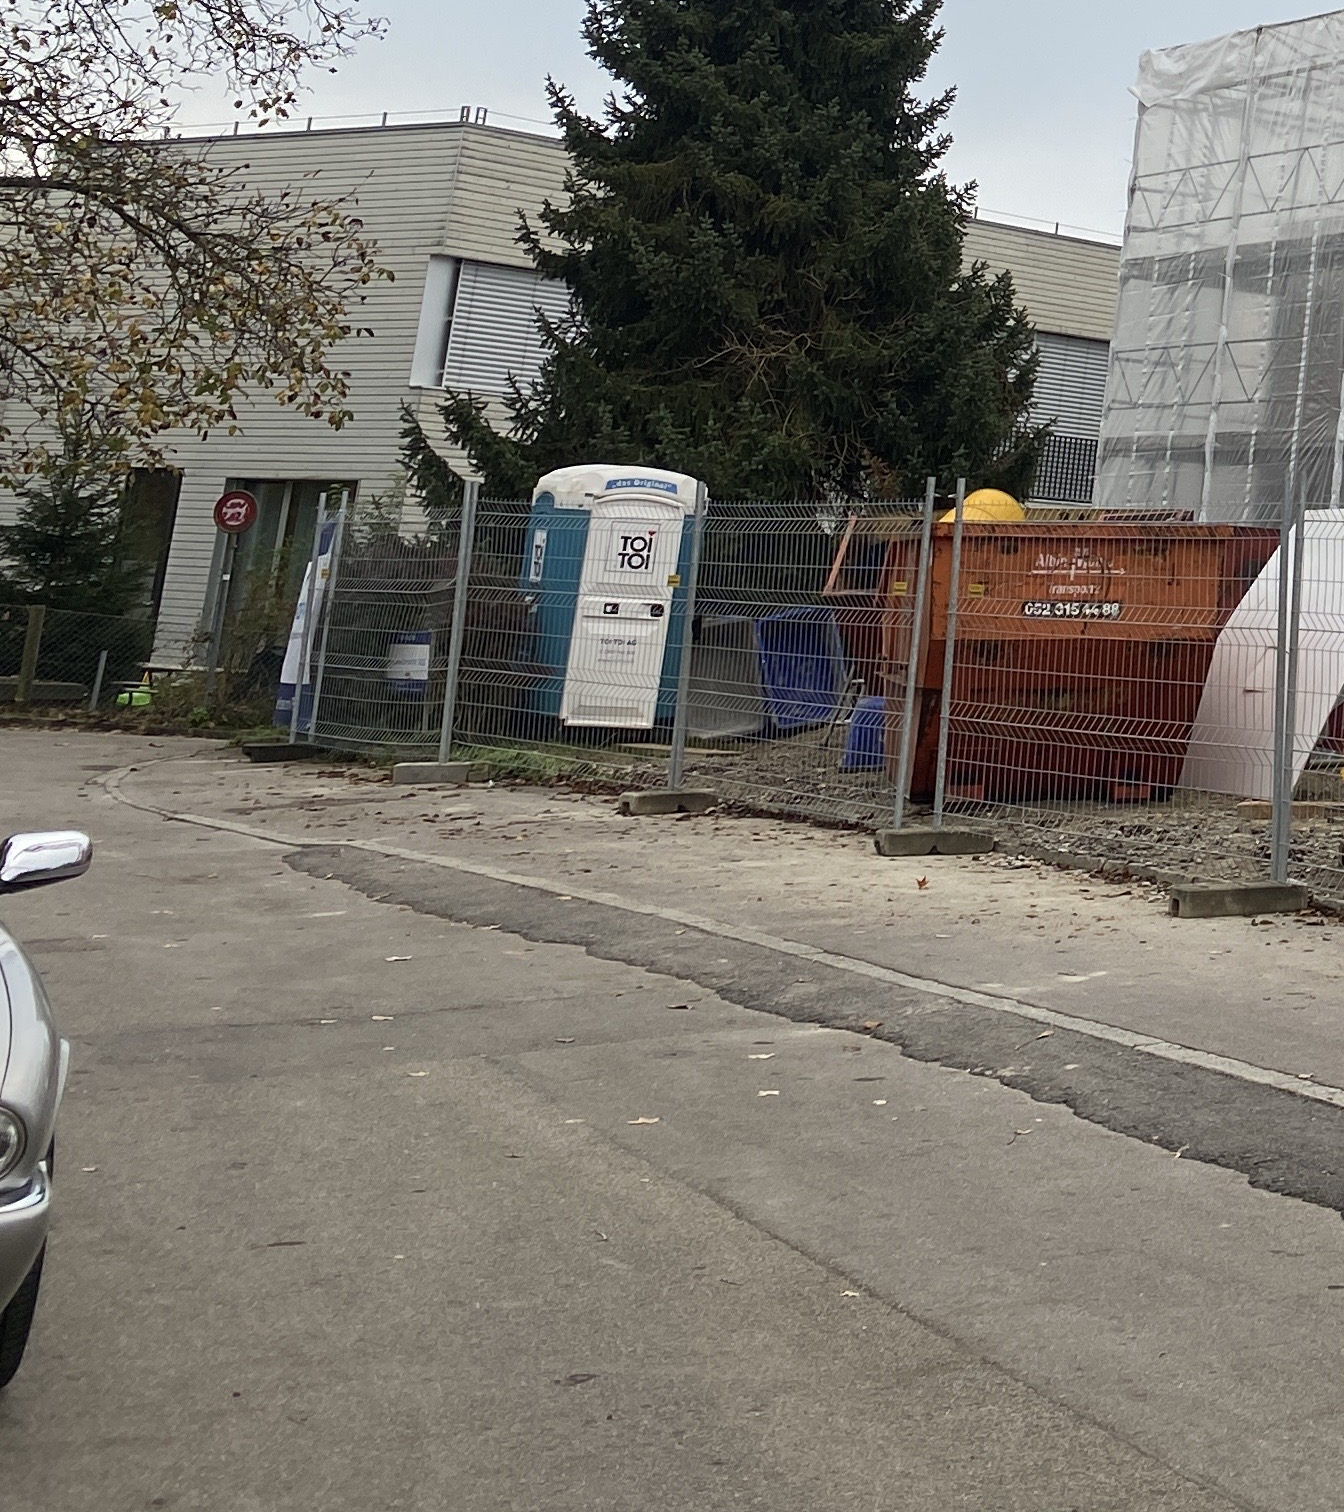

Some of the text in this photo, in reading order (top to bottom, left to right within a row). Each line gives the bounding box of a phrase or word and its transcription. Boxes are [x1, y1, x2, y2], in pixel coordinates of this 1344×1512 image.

[621, 531, 656, 553] TOI
[618, 553, 650, 570] TOI
[1024, 603, 1051, 615] 052
